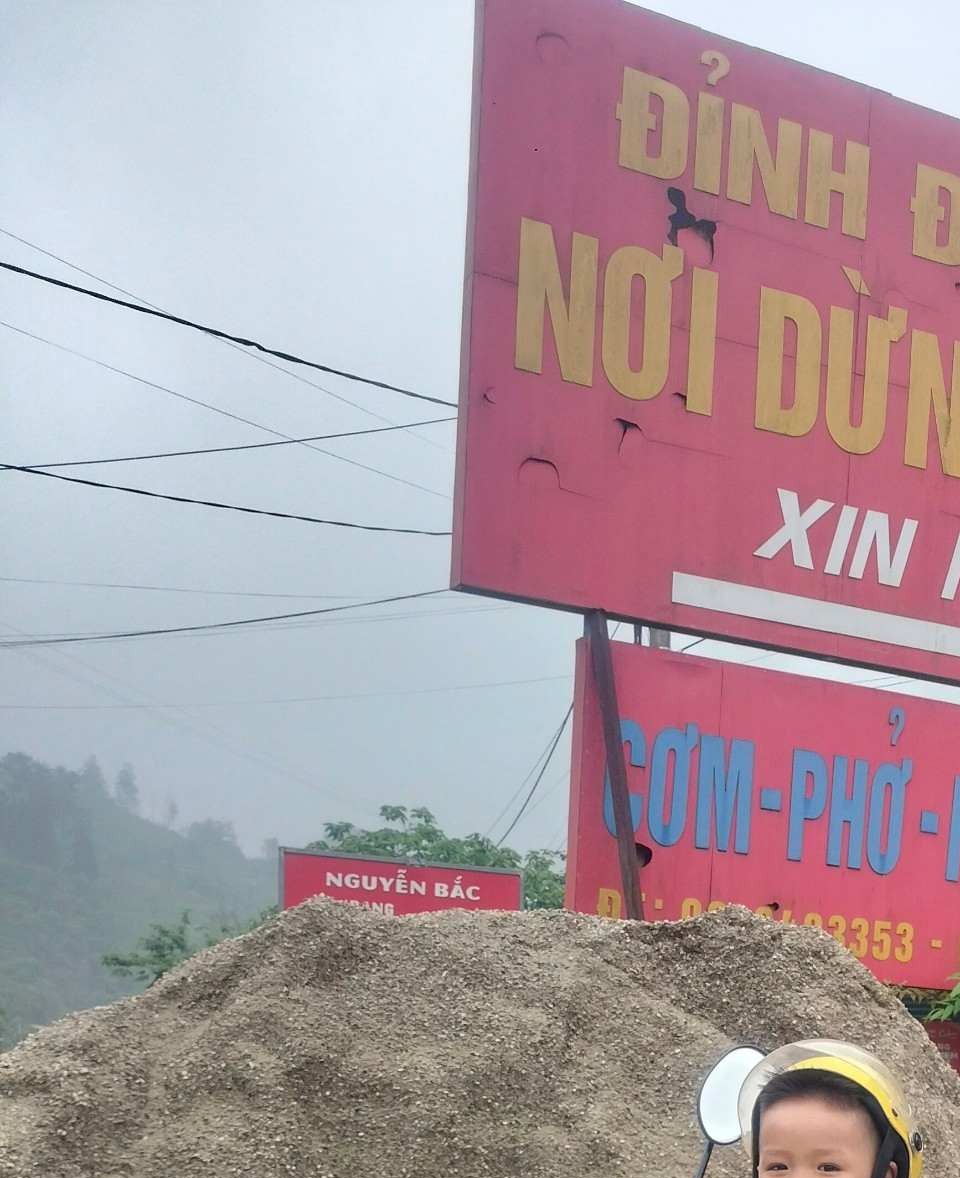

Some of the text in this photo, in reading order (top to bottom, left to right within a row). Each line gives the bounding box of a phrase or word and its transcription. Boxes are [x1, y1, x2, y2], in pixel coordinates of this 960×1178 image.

[615, 50, 870, 240] ĐỈNH
[514, 217, 719, 417] NƠI
[753, 488, 919, 587] XIN
[325, 869, 481, 900] NGUYỄN BẮC
